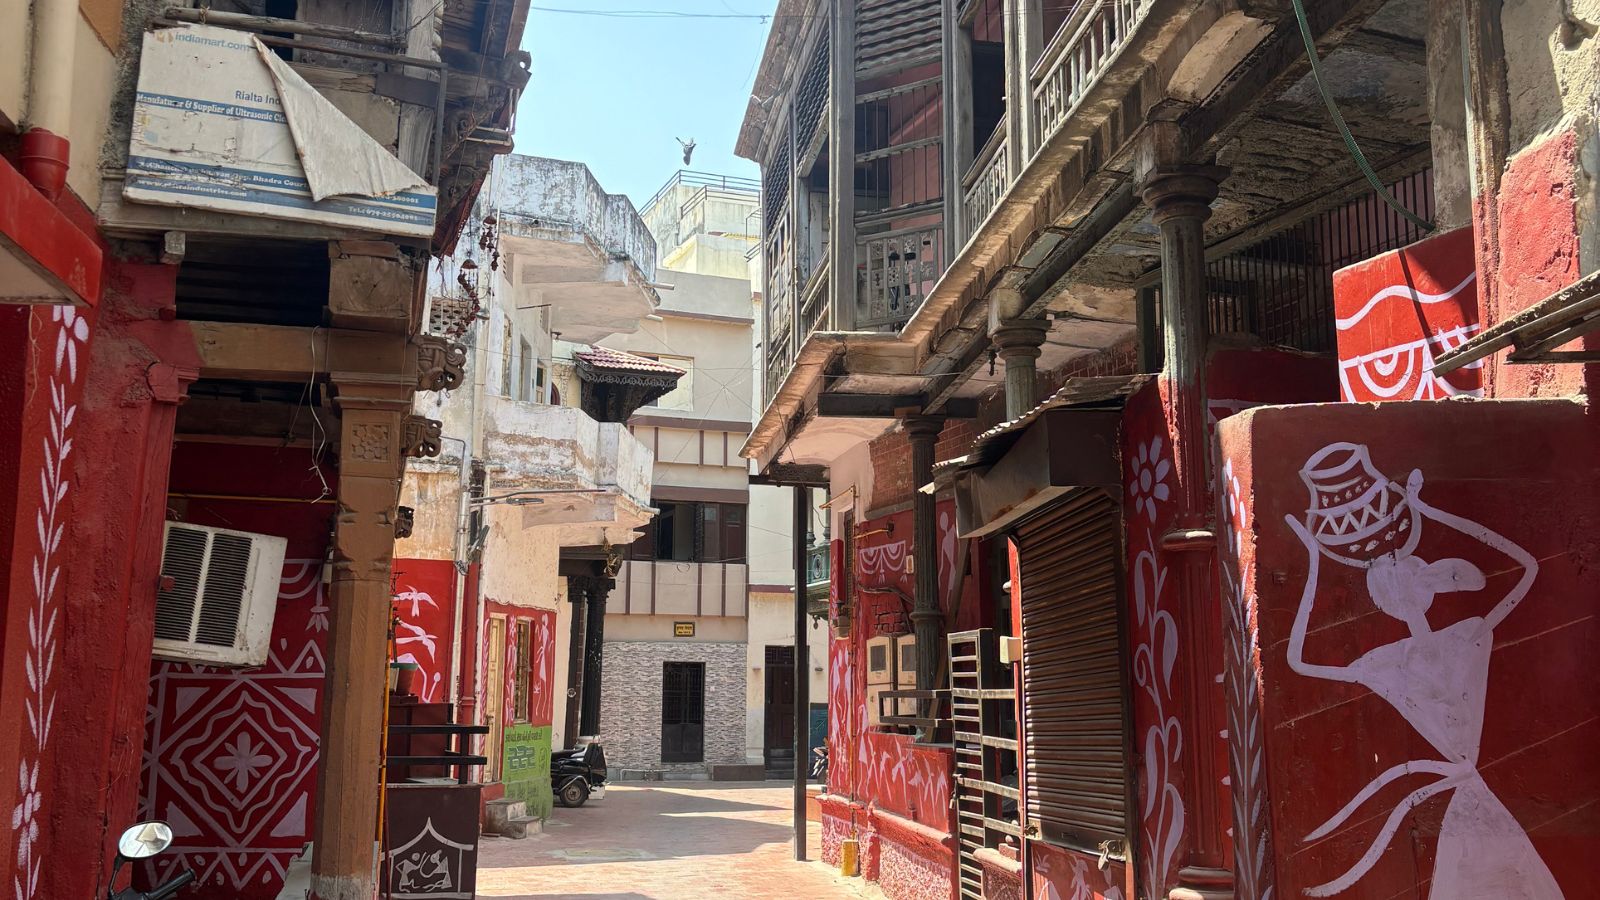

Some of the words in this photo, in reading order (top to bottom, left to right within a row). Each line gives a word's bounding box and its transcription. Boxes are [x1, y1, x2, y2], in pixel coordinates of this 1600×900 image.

[175, 31, 250, 52] indiamart.com
[235, 90, 263, 103] Rialta
[184, 100, 192, 109] &
[192, 101, 225, 113] Supplier
[225, 104, 234, 115] of
[235, 105, 273, 121] Ultrasonic
[252, 175, 282, 185] Bhadra
